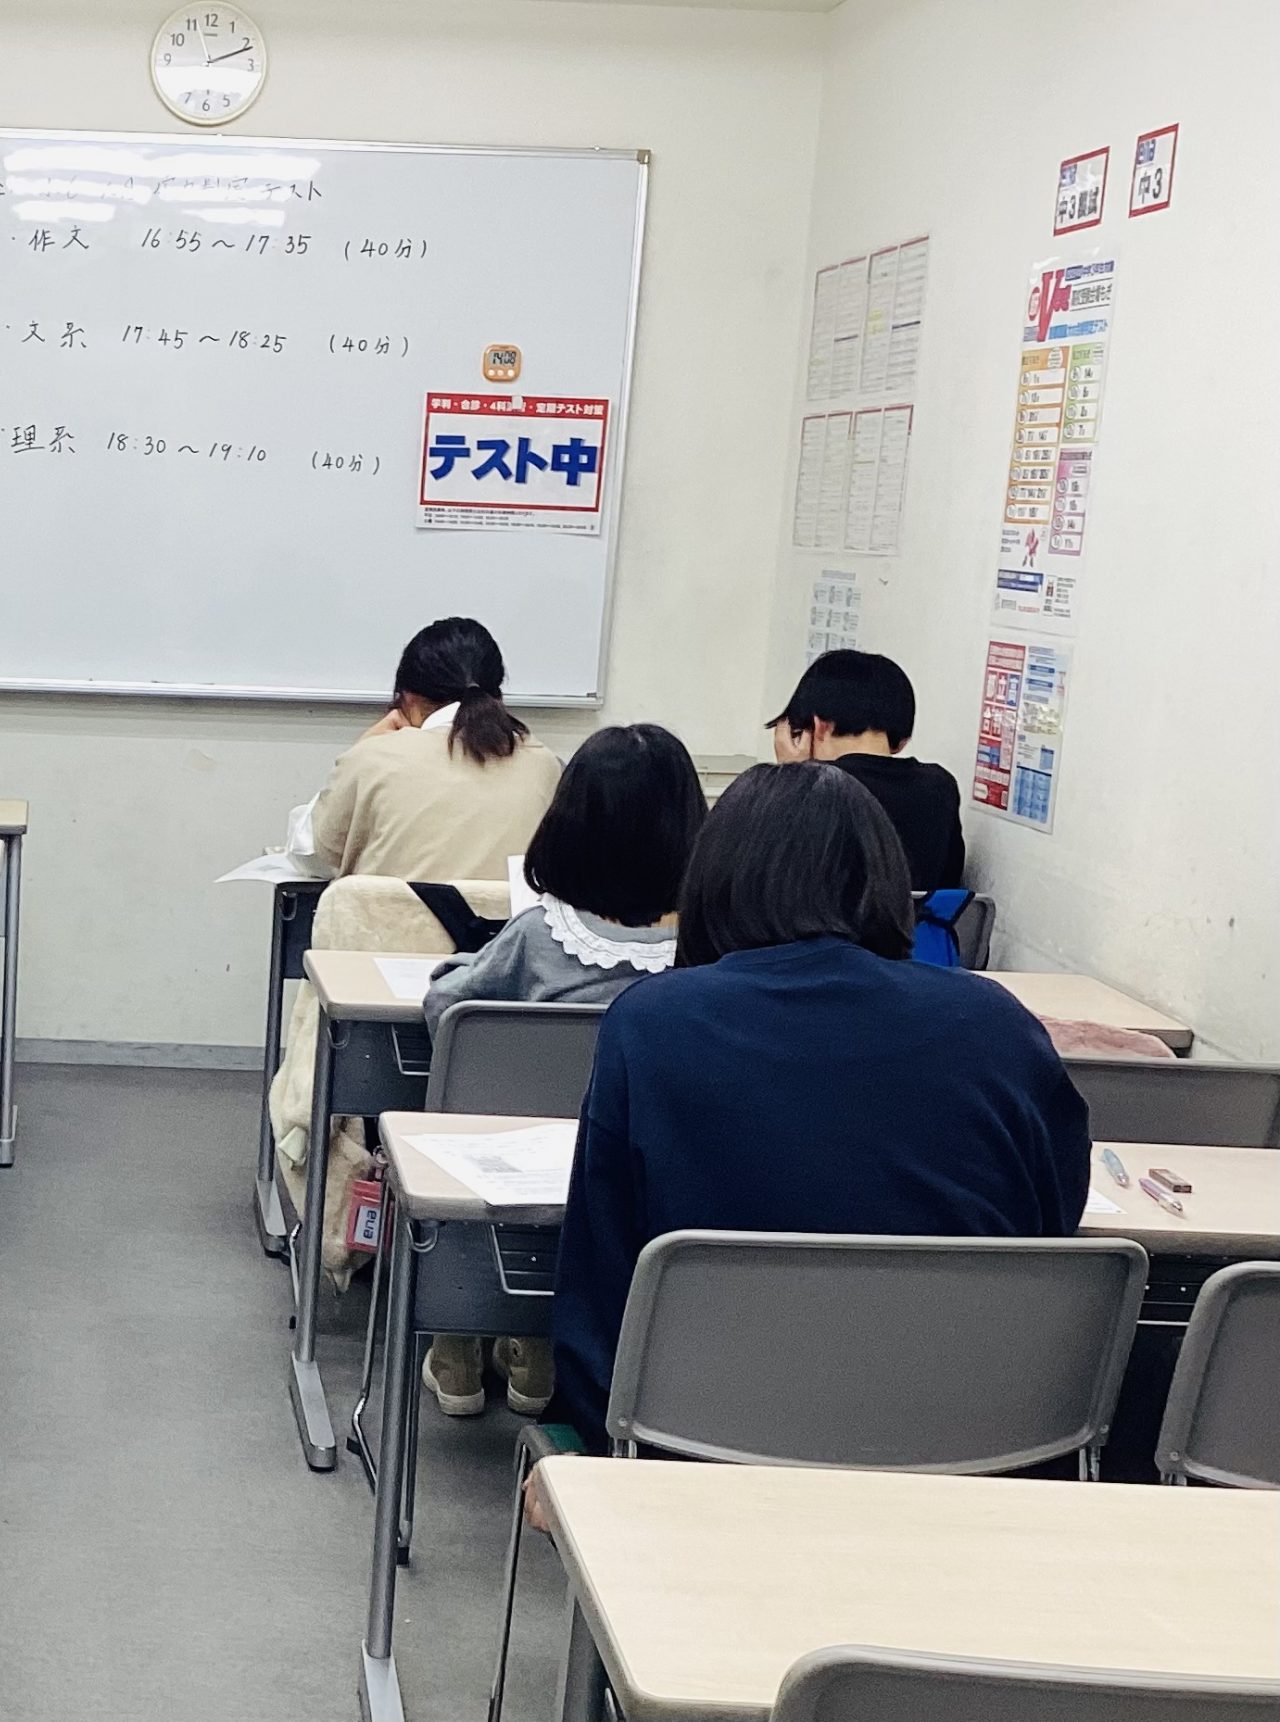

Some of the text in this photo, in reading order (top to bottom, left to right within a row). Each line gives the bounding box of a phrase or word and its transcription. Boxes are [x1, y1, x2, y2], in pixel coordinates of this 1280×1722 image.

[1138, 168, 1163, 204] 中3
[429, 435, 599, 486] テスト中
[363, 1210, 377, 1240] ena
